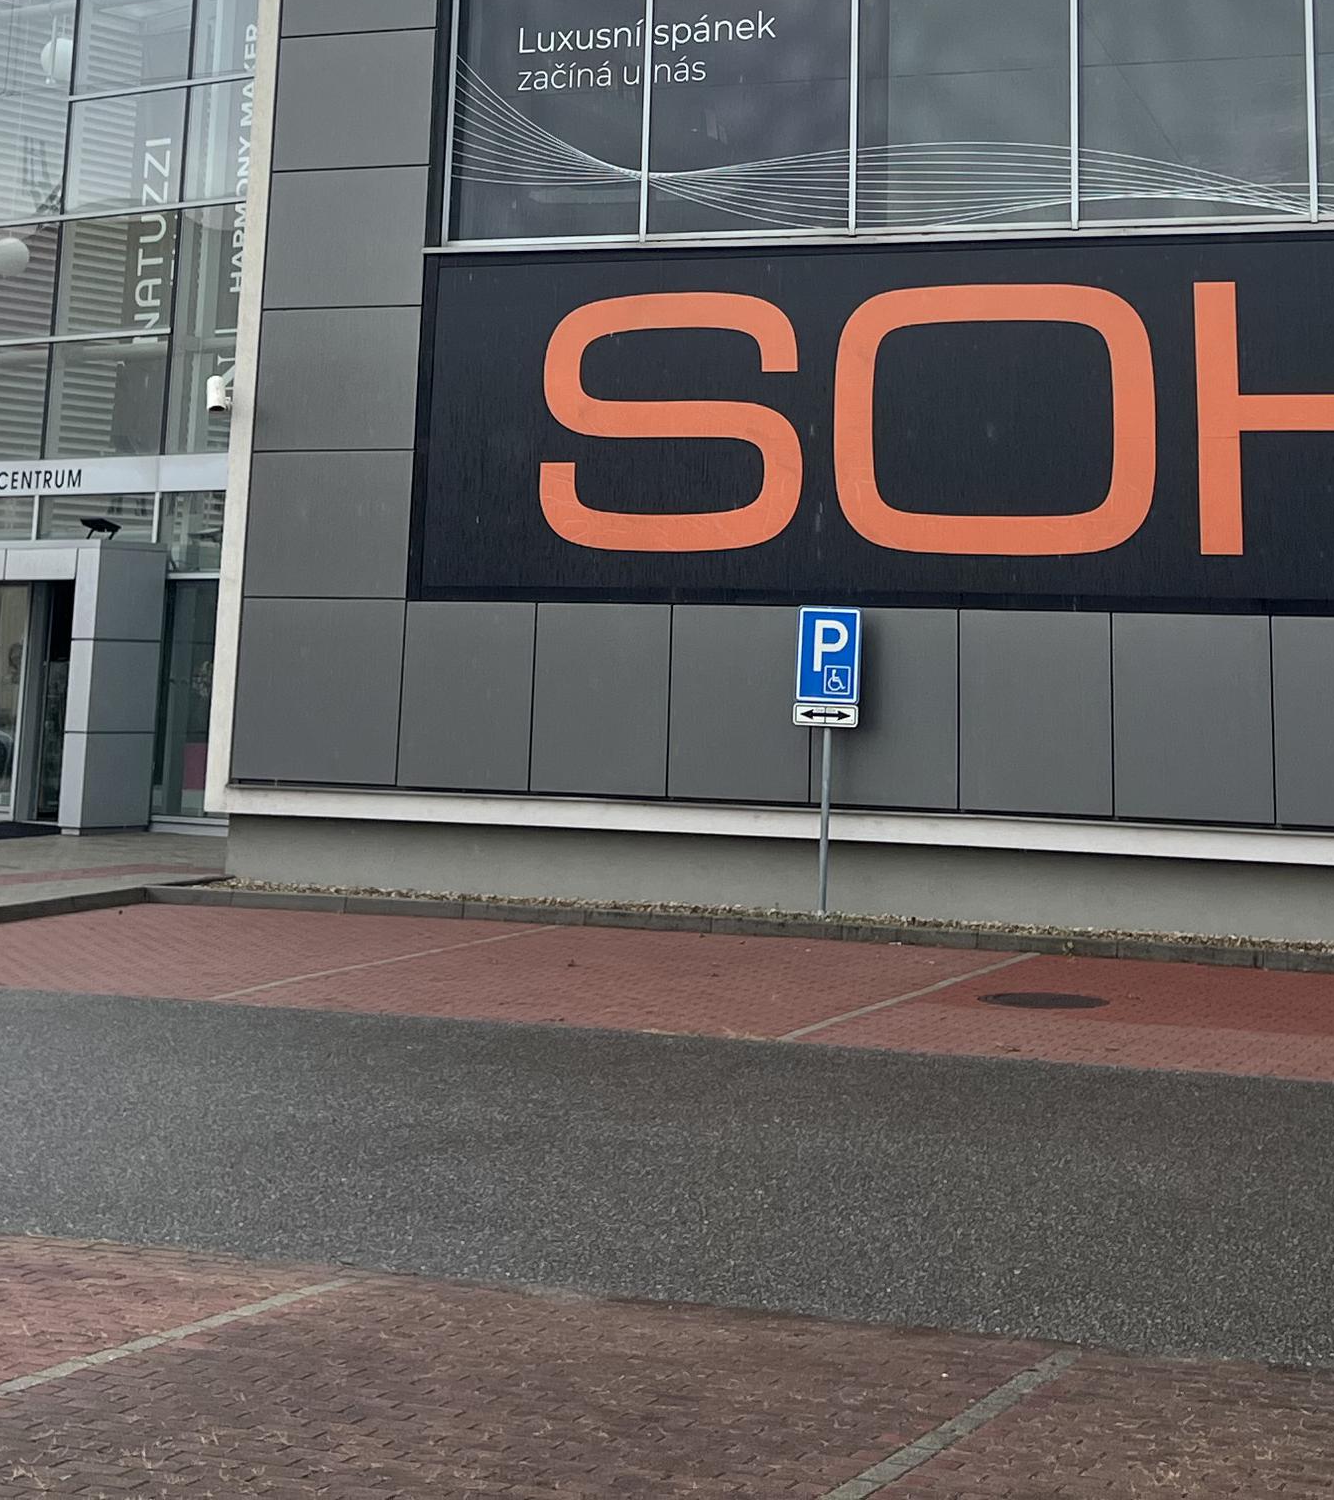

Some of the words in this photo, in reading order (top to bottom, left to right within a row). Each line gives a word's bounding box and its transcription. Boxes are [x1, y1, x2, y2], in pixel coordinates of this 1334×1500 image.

[518, 17, 644, 54] Luxusní
[653, 10, 776, 52] spánek
[517, 60, 612, 92] začíná
[623, 64, 641, 86] u
[653, 55, 707, 84] nás
[133, 137, 172, 345] NATUZZI
[813, 619, 849, 672] P
